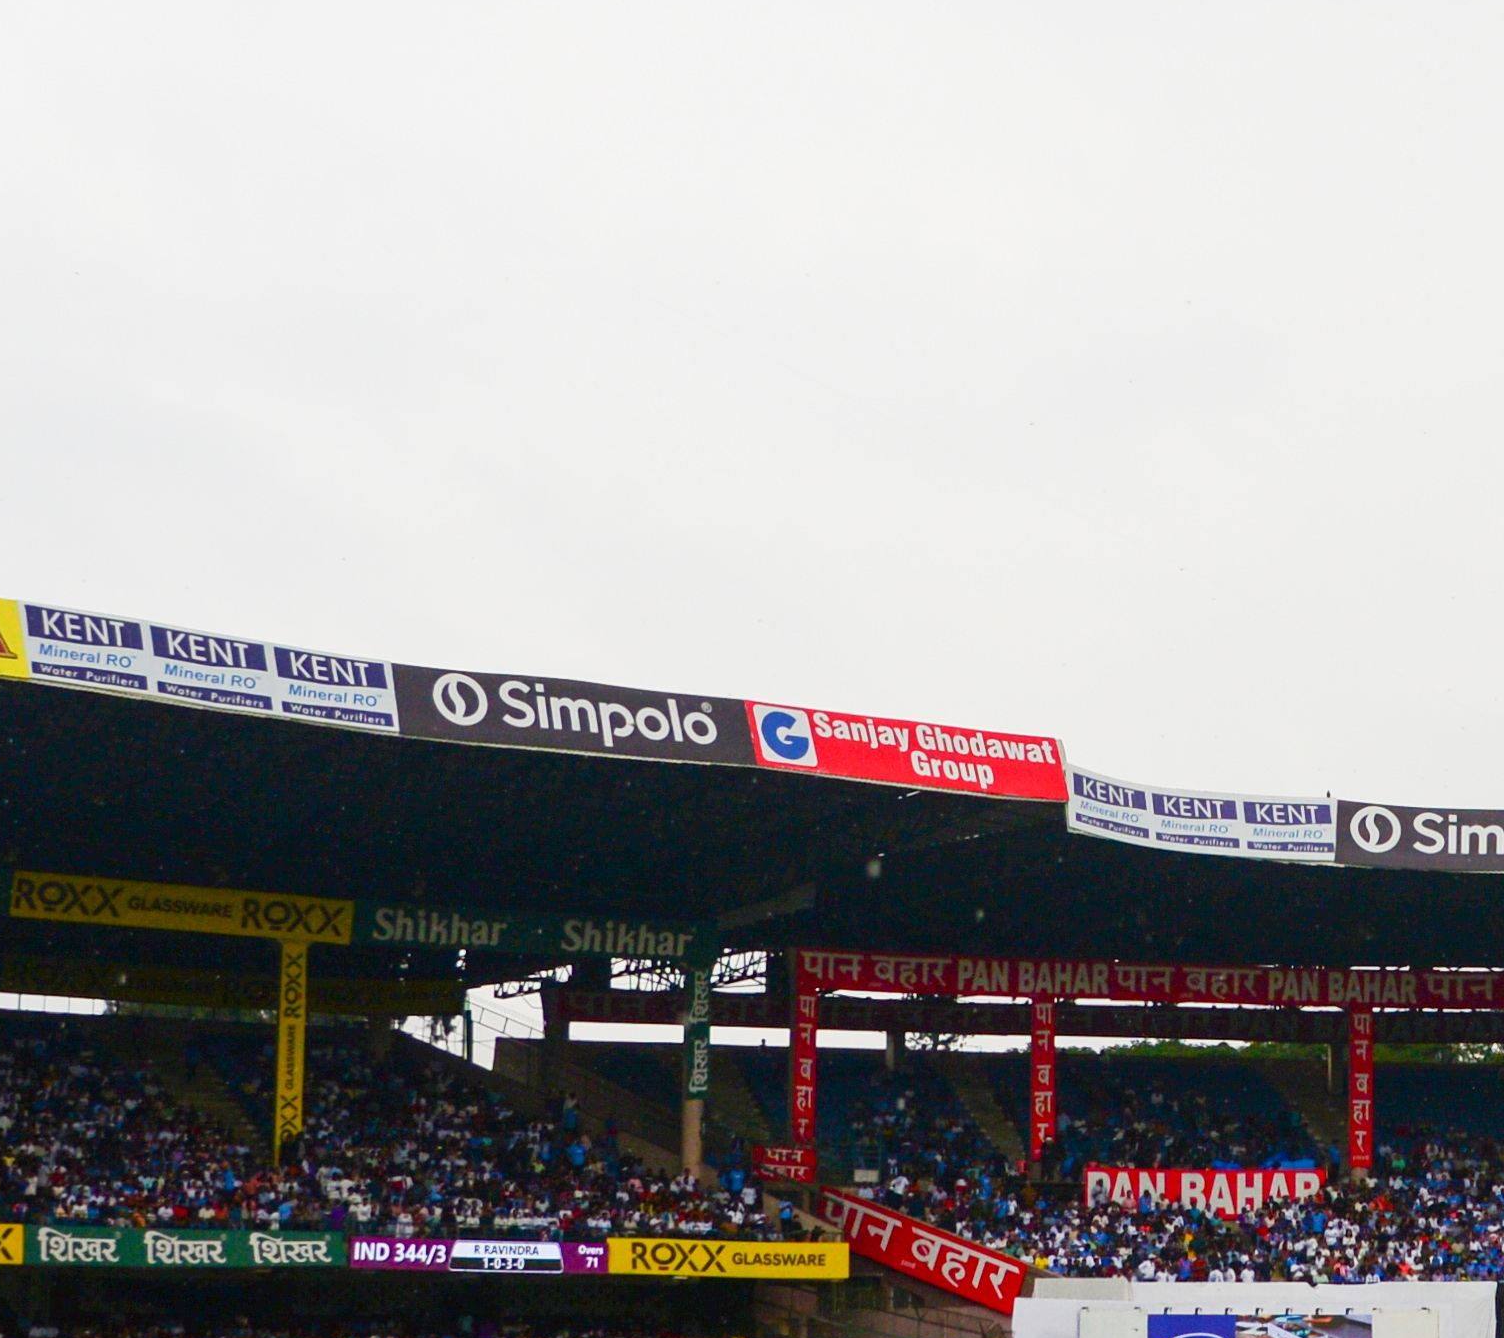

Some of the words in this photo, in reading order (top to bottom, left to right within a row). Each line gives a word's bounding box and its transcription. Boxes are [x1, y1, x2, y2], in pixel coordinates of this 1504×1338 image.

[41, 611, 126, 647] KENT
[38, 642, 102, 665] Mineral
[166, 633, 249, 669] KENT
[39, 663, 78, 680] Water
[85, 670, 141, 689] Purifiers
[288, 651, 371, 688] KENT
[814, 711, 910, 753] Sanjay
[915, 722, 1056, 765] Ghodawat
[911, 750, 994, 789] Group
[1159, 796, 1224, 818] KENT
[1252, 803, 1318, 824] KENT
[374, 907, 506, 946] Shikhar
[561, 920, 692, 957] Shikhar
[803, 953, 861, 985] पान
[873, 956, 953, 990] बहार
[956, 961, 1011, 993] PAN
[1018, 961, 1108, 994] BAHAR
[1268, 970, 1324, 999] PAN
[1332, 972, 1417, 1003] BAHAR
[37, 1227, 120, 1263] शिखर
[143, 1230, 226, 1265] शिखर
[249, 1231, 331, 1263] शिखर
[353, 1242, 390, 1262] IND
[395, 1242, 447, 1265] 344/3
[474, 1245, 481, 1255] R
[484, 1245, 539, 1257] RAVINDRA
[578, 1245, 604, 1256] Overs
[586, 1256, 598, 1268] 71
[632, 1243, 726, 1272] ROXX
[732, 1253, 826, 1266] GLASSWARE
[822, 1195, 898, 1251] पान
[910, 1230, 1021, 1301] बहार
[482, 1258, 525, 1270] 1-0-3-0
